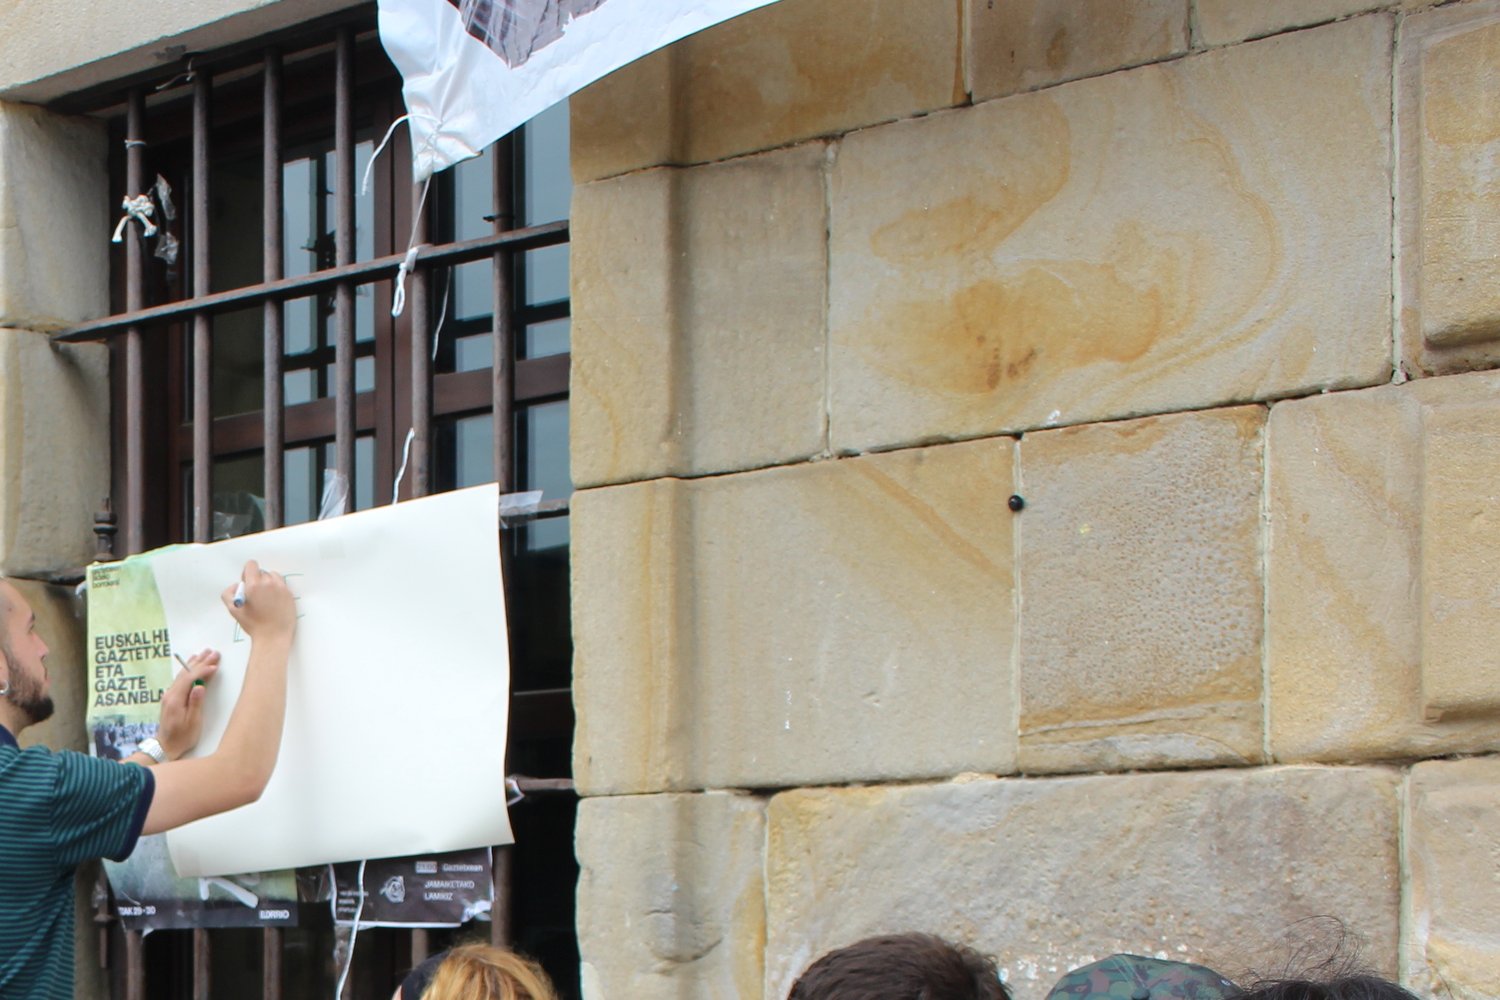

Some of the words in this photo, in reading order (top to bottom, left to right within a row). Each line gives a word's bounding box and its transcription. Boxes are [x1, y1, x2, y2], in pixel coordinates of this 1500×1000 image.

[95, 632, 150, 650] EUSKAL
[94, 643, 172, 664] GAZTETXE
[95, 663, 124, 679] ETA
[95, 675, 148, 693] GAZTE
